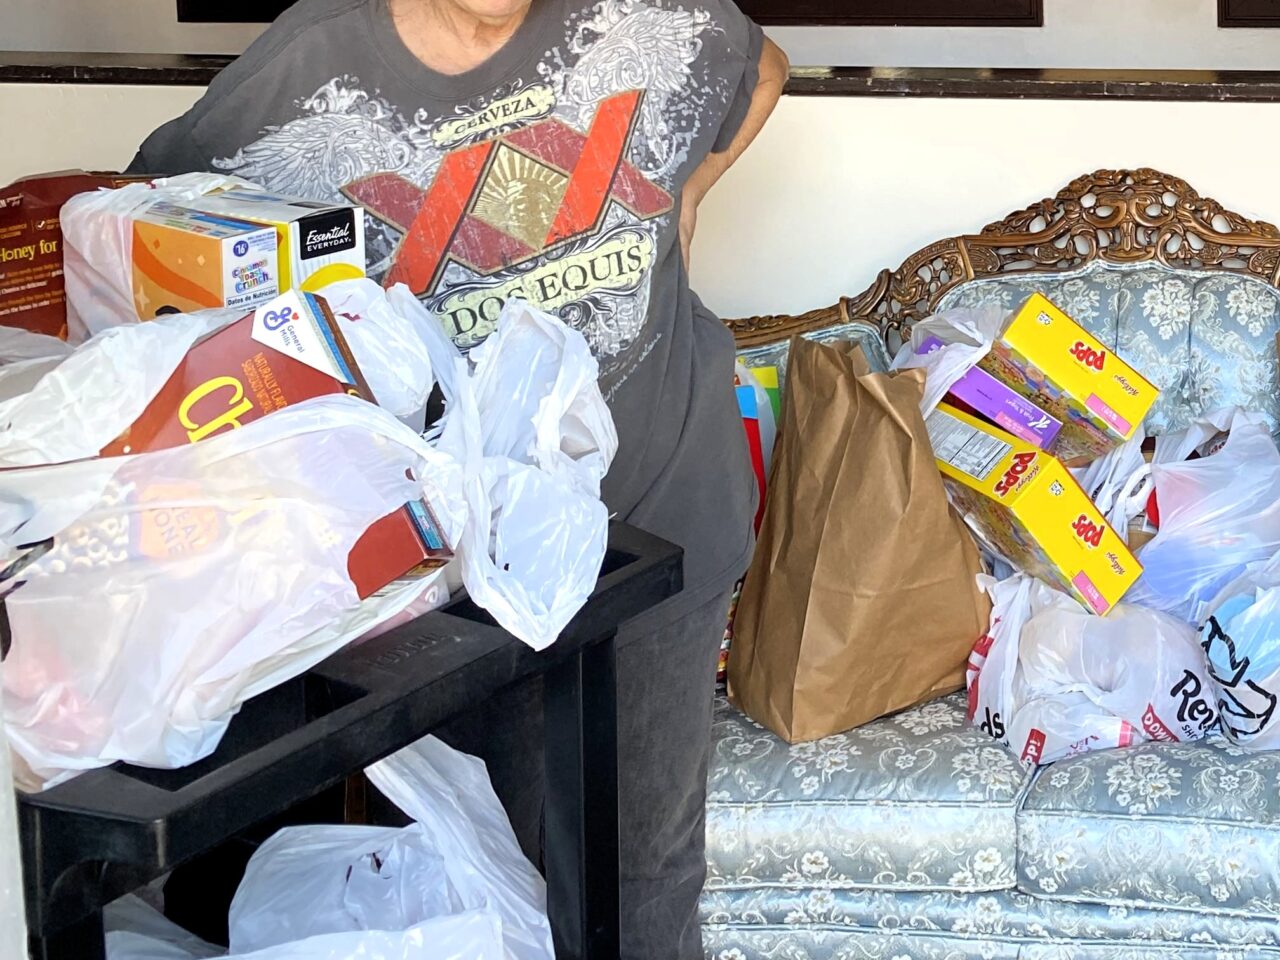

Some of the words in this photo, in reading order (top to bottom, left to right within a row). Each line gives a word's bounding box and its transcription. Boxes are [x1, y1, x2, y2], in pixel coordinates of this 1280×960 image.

[455, 96, 536, 134] CERVEZA
[40, 239, 58, 255] for
[306, 223, 350, 246] Essential
[307, 238, 350, 252] EVERYDAY
[235, 272, 269, 293] Crunch
[536, 244, 644, 302] EQUIS
[279, 329, 290, 347] Mills
[287, 325, 304, 353] General
[1069, 341, 1106, 371] POPS
[994, 452, 1037, 497] POPS
[1072, 514, 1105, 547] POPS
